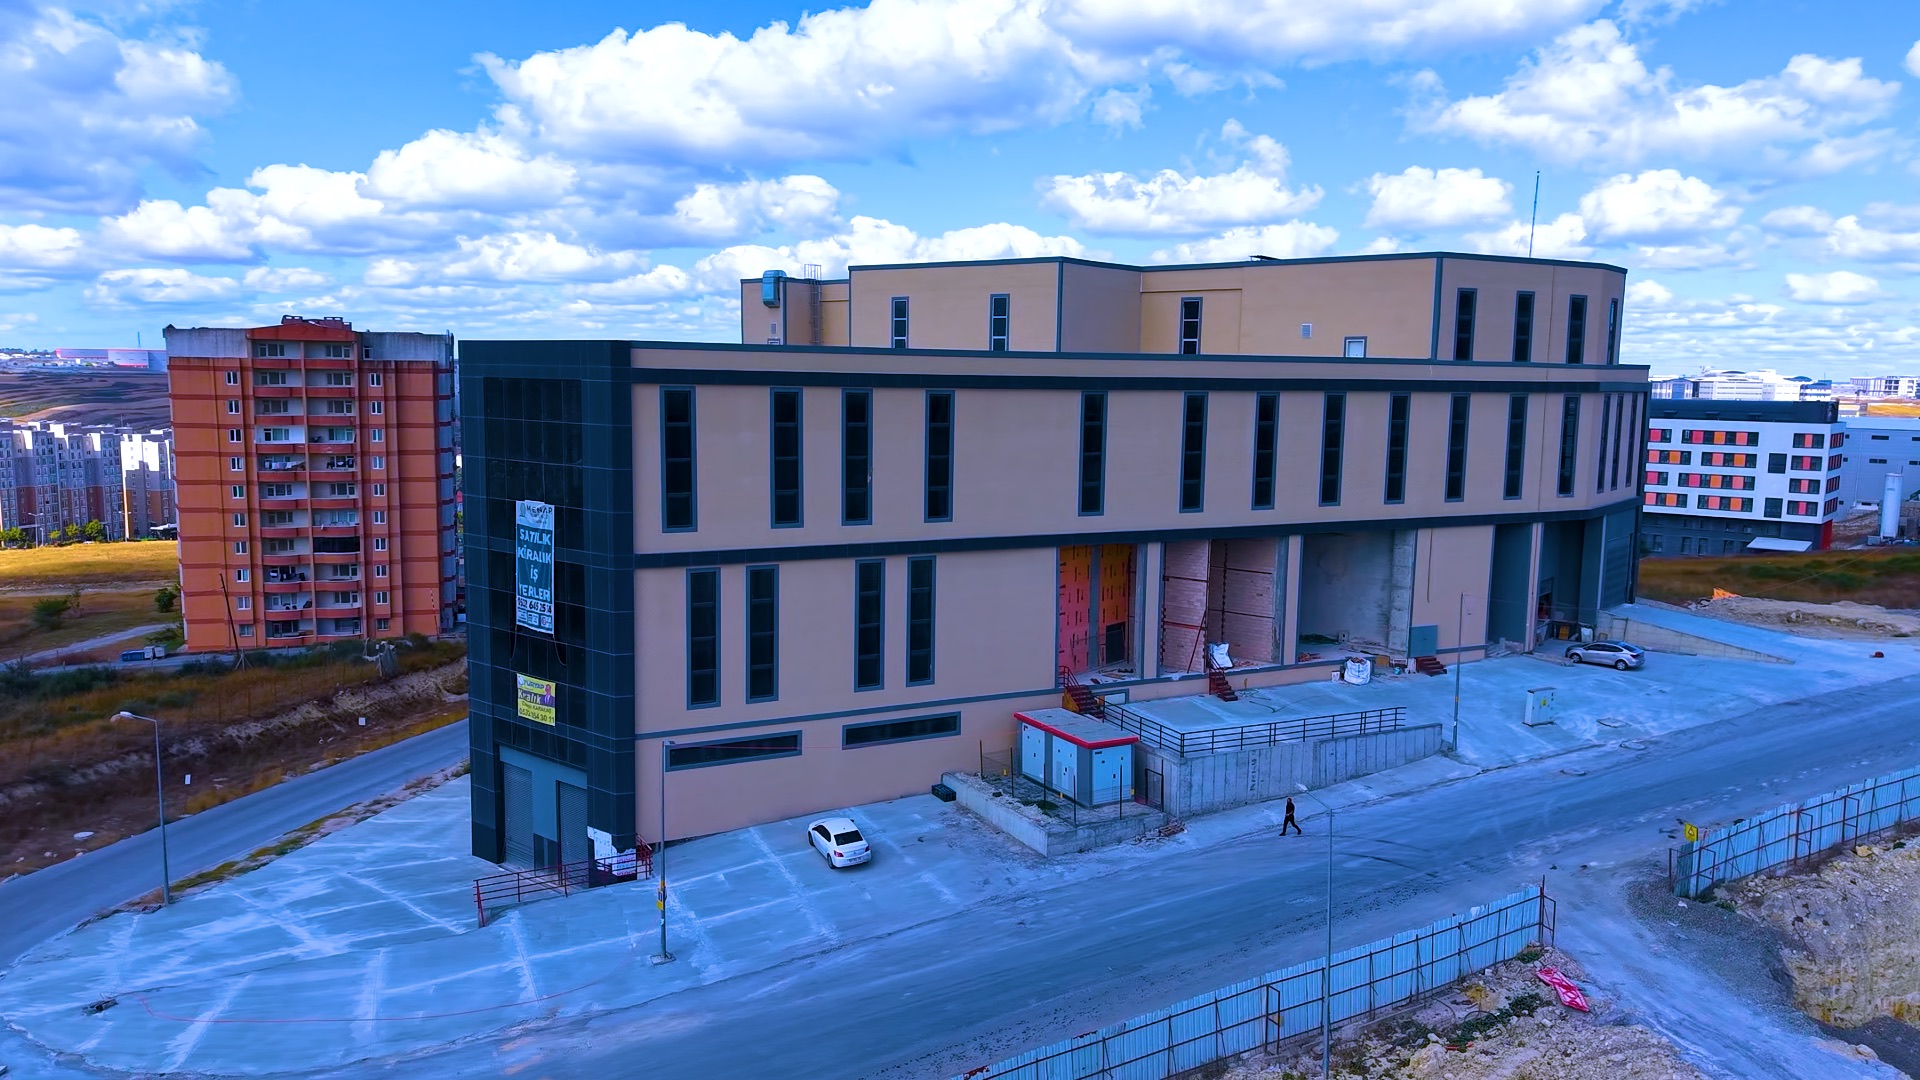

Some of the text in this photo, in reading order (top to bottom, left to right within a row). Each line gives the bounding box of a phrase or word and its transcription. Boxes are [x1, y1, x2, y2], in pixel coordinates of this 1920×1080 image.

[520, 529, 551, 546] SATILIK
[517, 544, 552, 564] KİRALIK
[530, 564, 539, 583] İŞ
